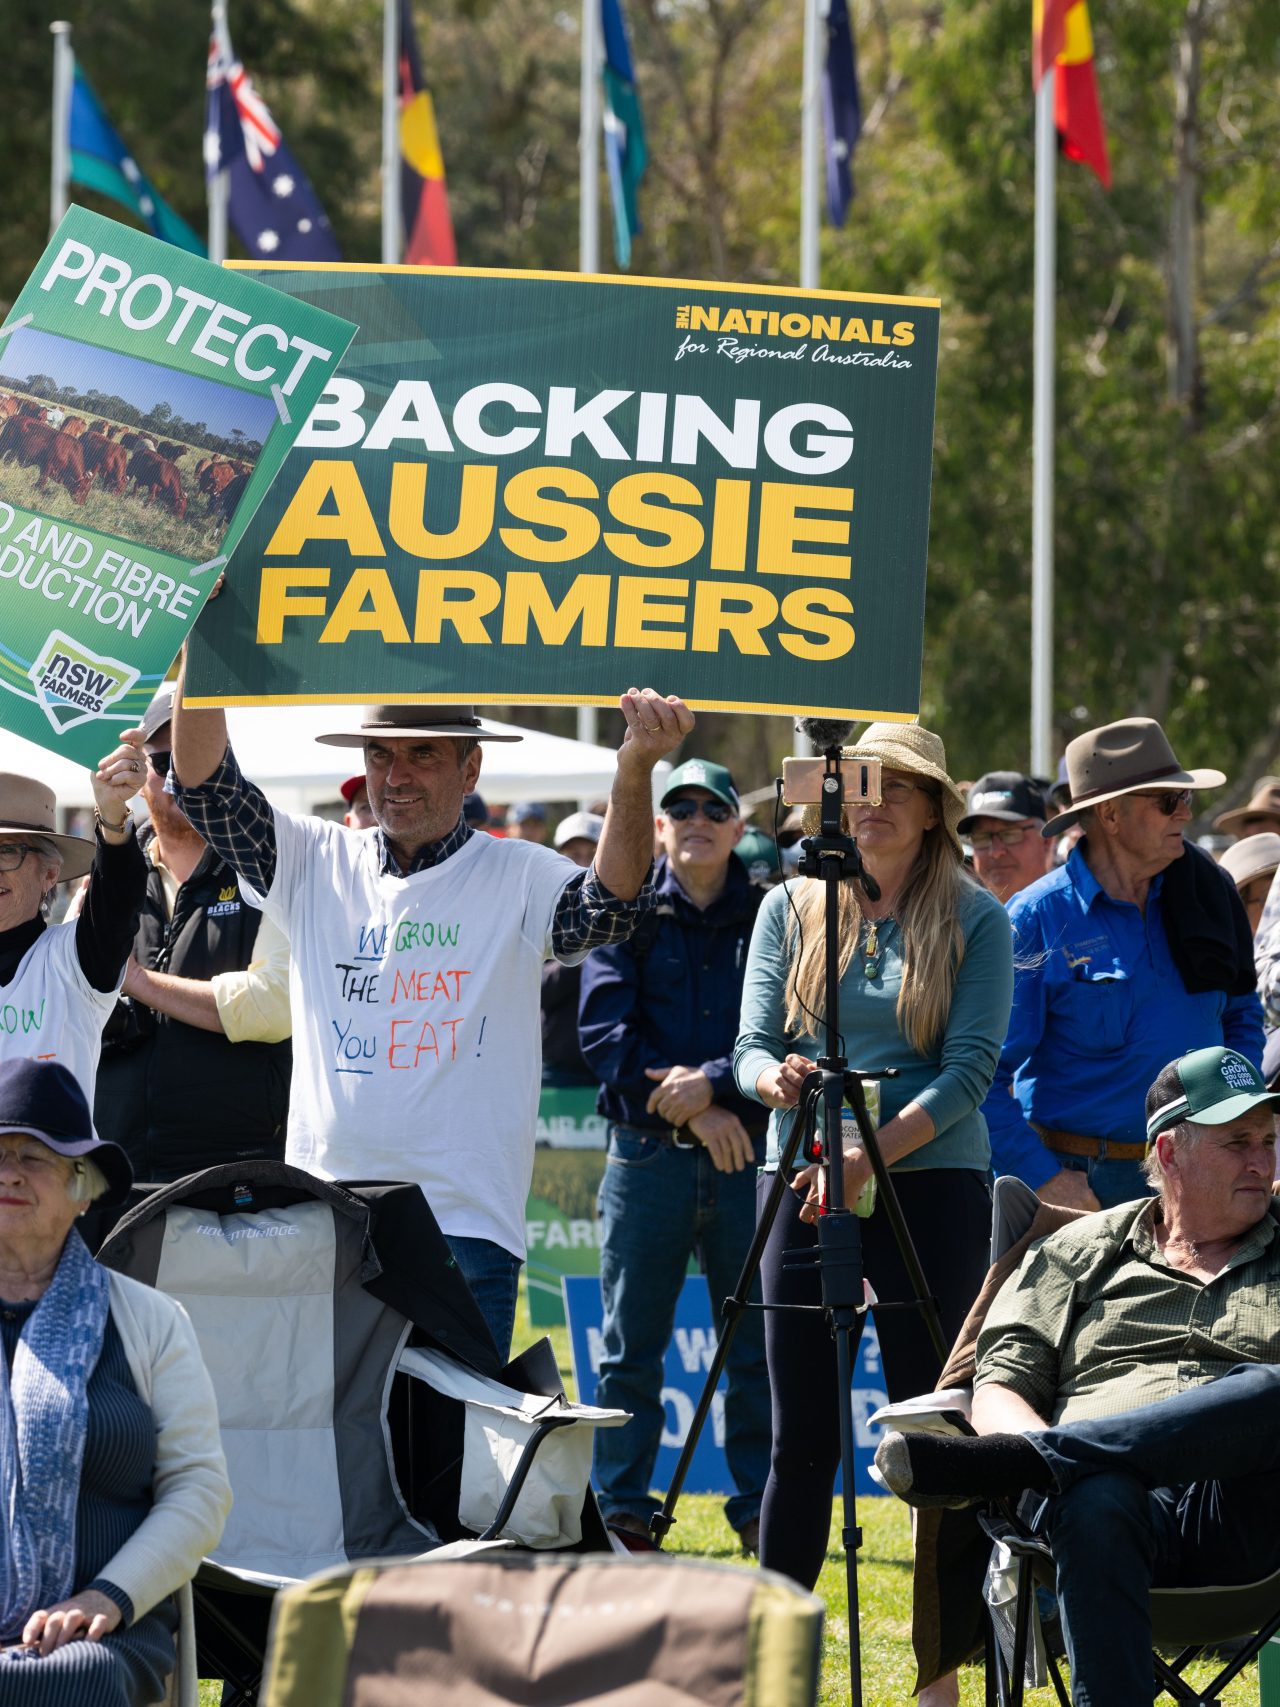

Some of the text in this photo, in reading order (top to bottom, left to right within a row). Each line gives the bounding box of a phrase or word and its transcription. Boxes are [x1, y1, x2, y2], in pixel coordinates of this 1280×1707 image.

[40, 239, 331, 396] PROTECT
[676, 305, 915, 346] THE NATIONALS
[675, 334, 913, 369] for Regional Australia
[294, 377, 854, 475] BACKING
[264, 460, 855, 580] AUSSIE
[14, 517, 91, 569] AND
[91, 547, 201, 620] FIBRE
[256, 566, 856, 661] FARMERS
[39, 675, 103, 713] FARMERS
[46, 654, 113, 697] nsw
[207, 902, 240, 914] BLACKS
[395, 921, 460, 951] GROW
[335, 964, 472, 1004] THE MEAT
[1221, 1064, 1248, 1076] GROW
[1227, 1078, 1255, 1089] THING
